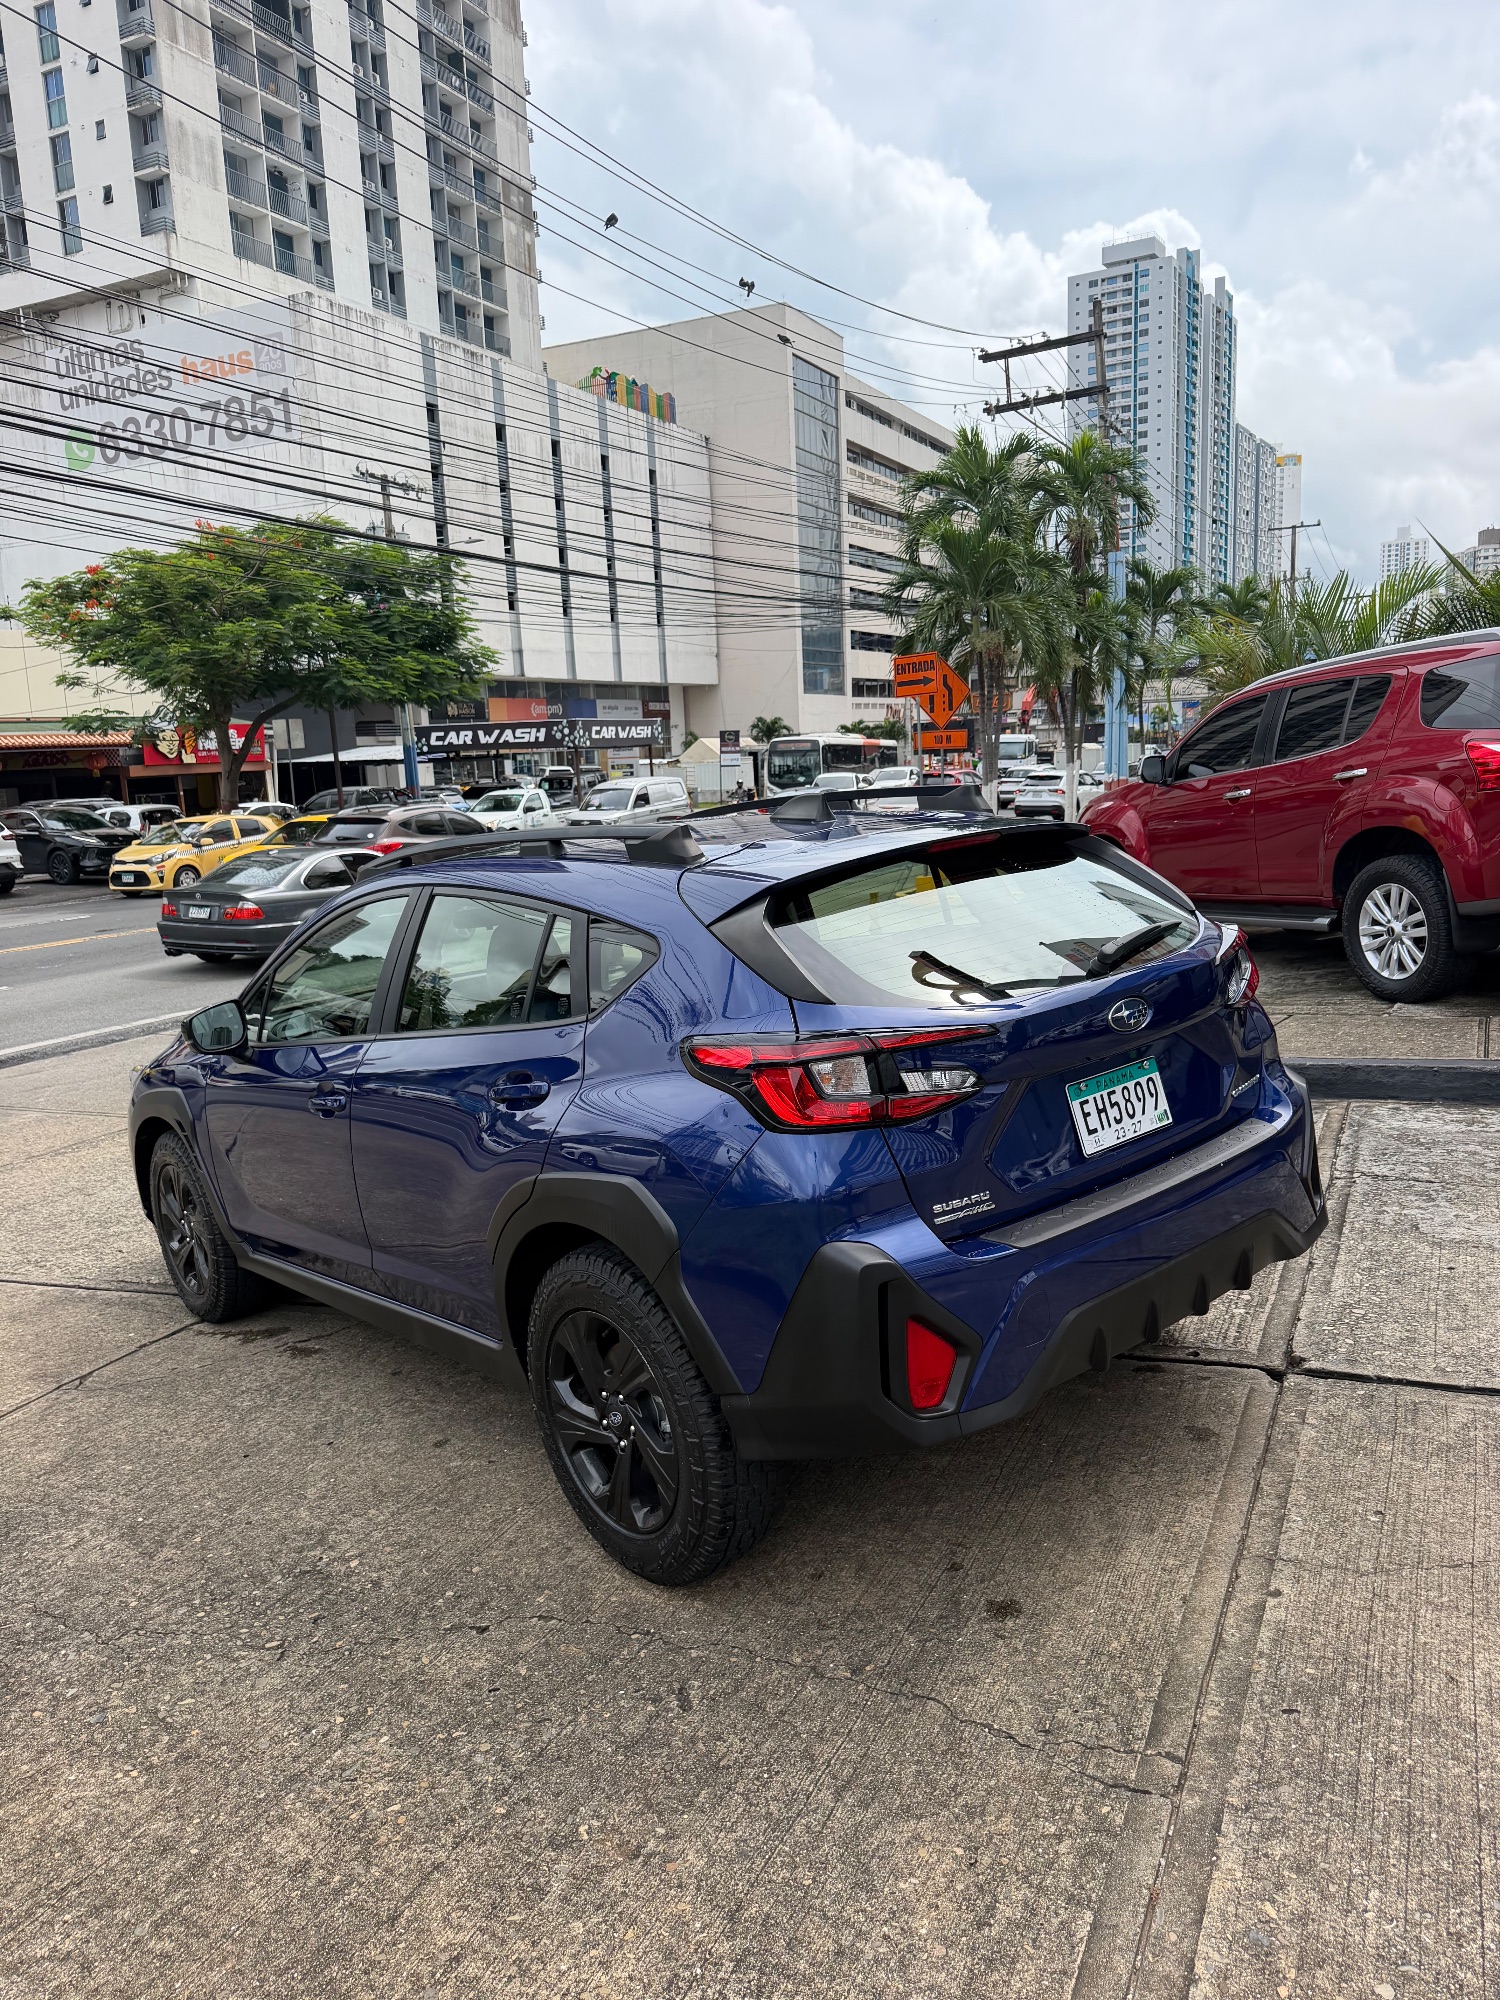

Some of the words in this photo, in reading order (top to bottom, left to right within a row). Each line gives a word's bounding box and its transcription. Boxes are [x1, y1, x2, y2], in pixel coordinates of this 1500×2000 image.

[54, 337, 146, 380] últimas
[257, 336, 281, 361] 20
[180, 349, 255, 386] haus
[59, 367, 174, 412] unidades
[99, 386, 294, 465] 6330-7851
[896, 660, 936, 676] ENTRADA
[429, 729, 473, 746] CAR
[477, 727, 547, 744] WASH
[591, 726, 616, 739] CAR
[617, 725, 652, 739] WASH
[945, 734, 952, 744] M
[1079, 1076, 1159, 1136] EH5899
[932, 1190, 990, 1214] SUBARU
